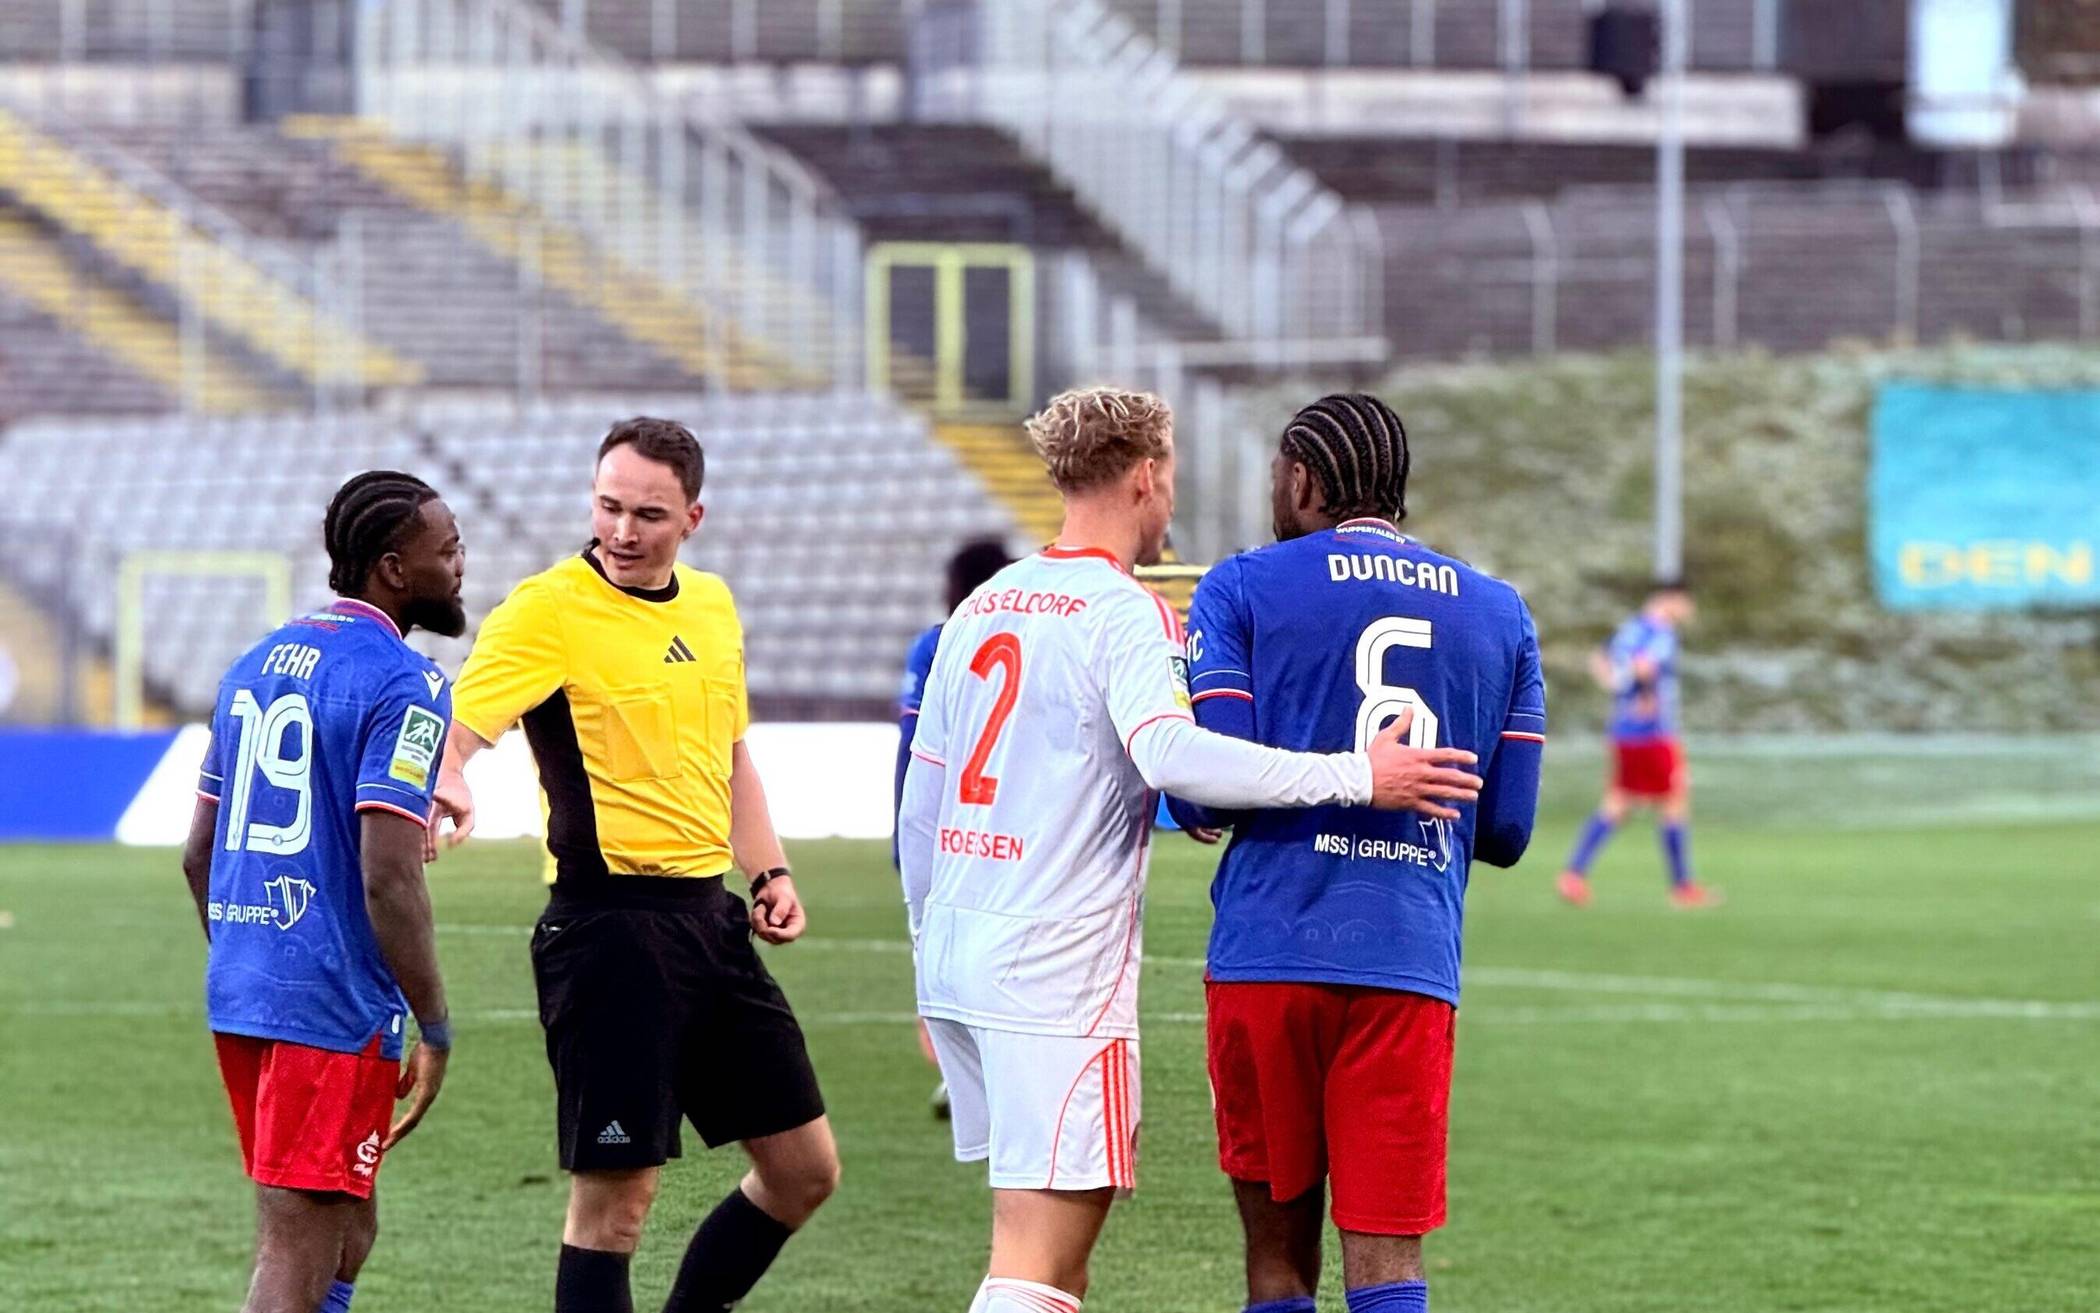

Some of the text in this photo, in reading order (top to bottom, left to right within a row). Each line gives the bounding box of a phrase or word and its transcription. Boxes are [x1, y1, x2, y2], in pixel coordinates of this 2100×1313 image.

[1327, 553, 1459, 597] DUNCAN
[262, 643, 321, 681] FEHR
[1355, 616, 1439, 754] 6
[959, 631, 1023, 806] 2
[225, 689, 314, 856] 19
[1314, 834, 1429, 867] MSS GRUPPE
[208, 902, 272, 926] SS GRUPPE
[597, 1135, 631, 1144] adidas
